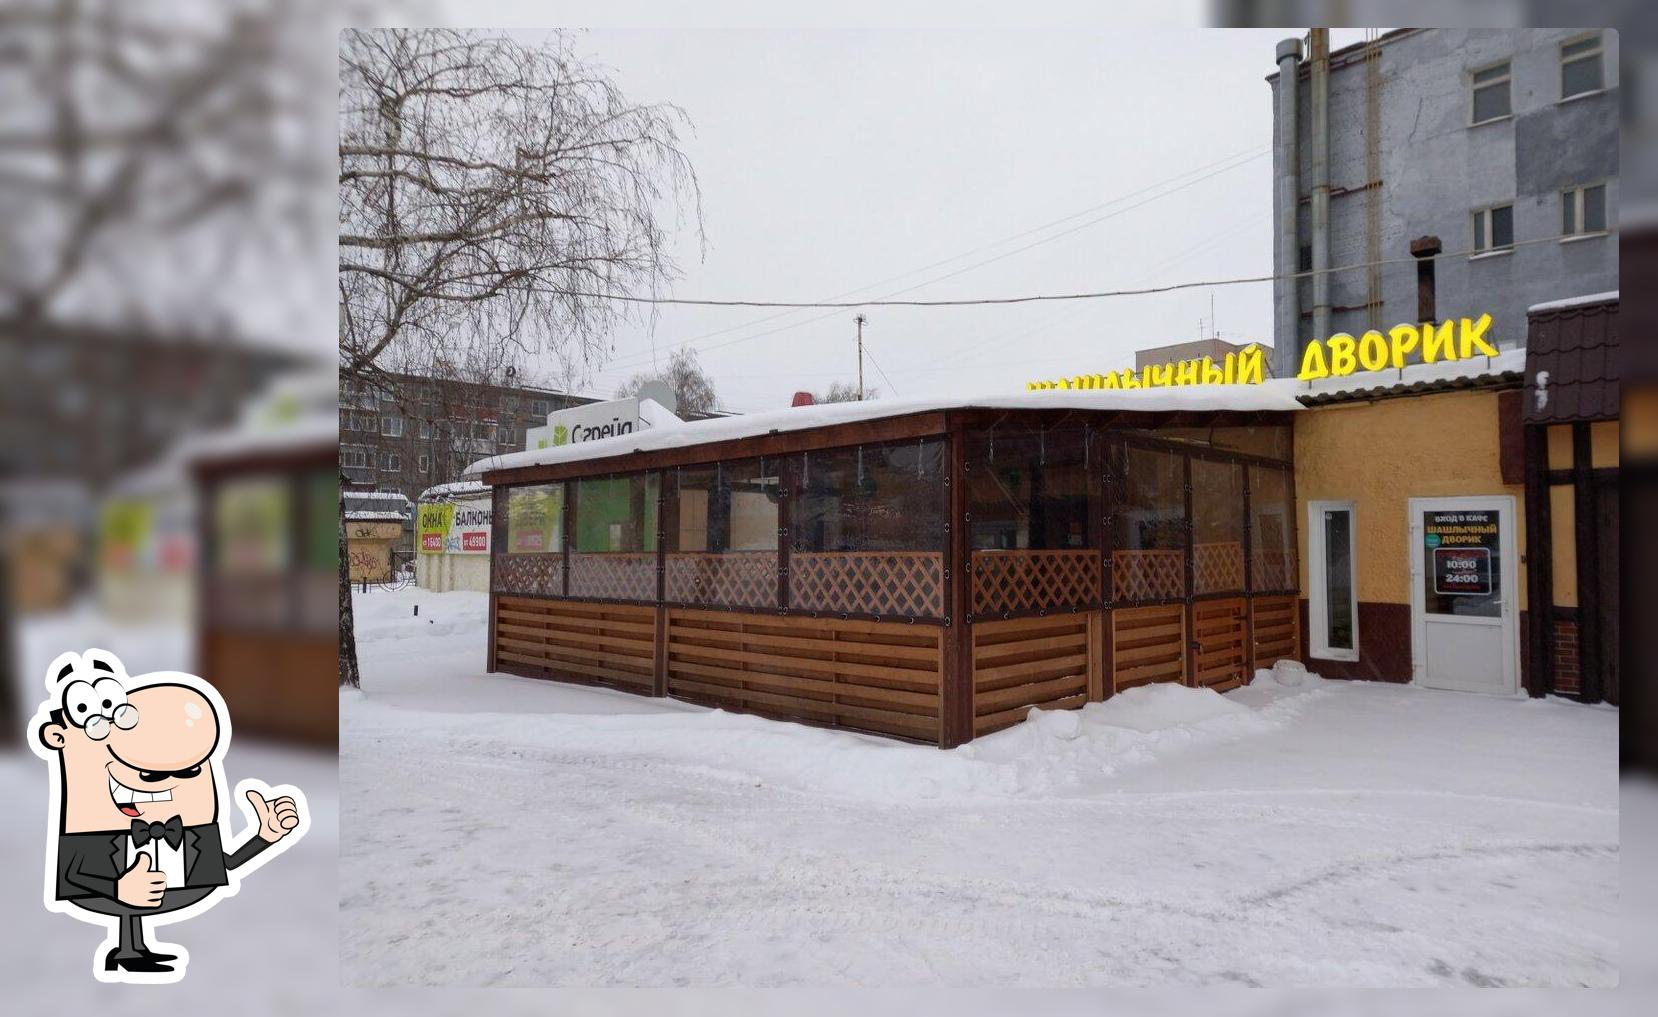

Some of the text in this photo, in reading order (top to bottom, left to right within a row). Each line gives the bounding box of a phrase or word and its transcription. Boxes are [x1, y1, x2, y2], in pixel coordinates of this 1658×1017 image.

[1297, 312, 1499, 381] ДВОРИК
[1427, 523, 1497, 534] ШАШЛЫЧНЫЙ
[1442, 535, 1482, 545] ДВОРИК
[1446, 560, 1477, 569] 10:00
[1446, 574, 1479, 583] 24:00
